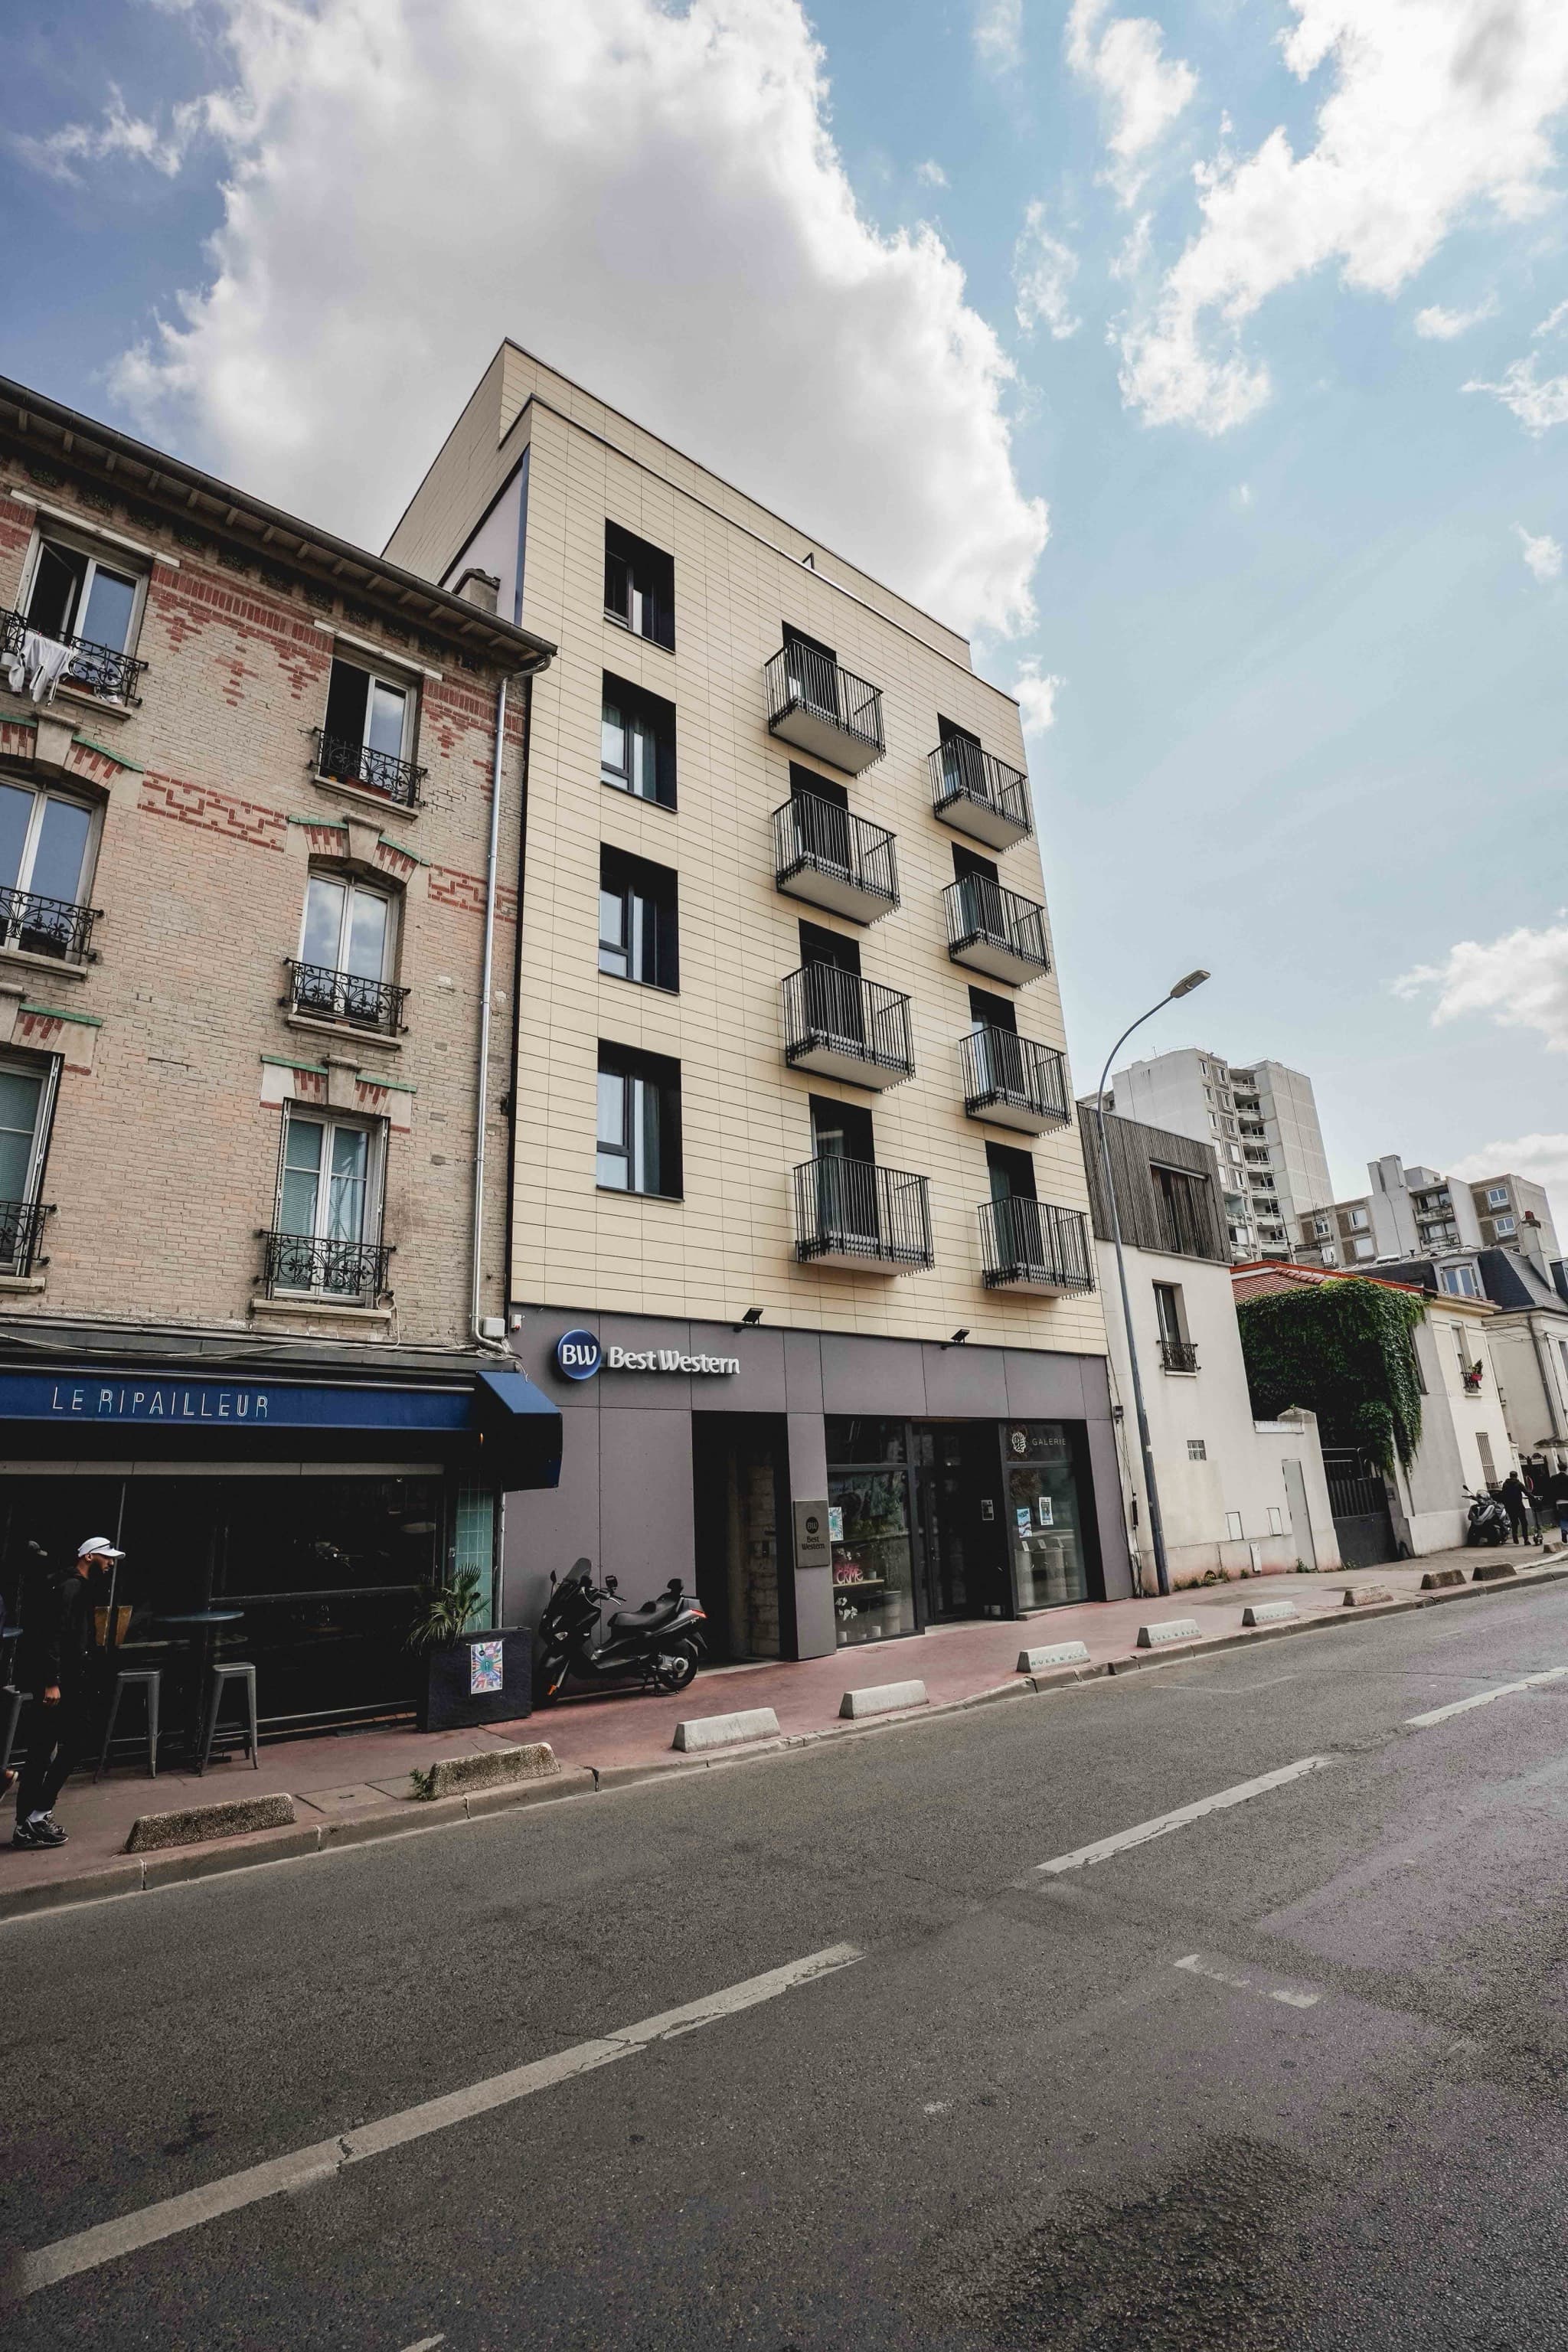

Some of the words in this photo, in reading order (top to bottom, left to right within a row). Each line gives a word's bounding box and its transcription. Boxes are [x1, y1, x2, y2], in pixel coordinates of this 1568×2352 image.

[561, 1344, 597, 1367] BW
[607, 1346, 657, 1371] Best
[658, 1349, 740, 1374] Western
[52, 1387, 85, 1410] LE
[97, 1388, 269, 1418] RIPAILLEUR
[1031, 1438, 1067, 1446] GALERIE
